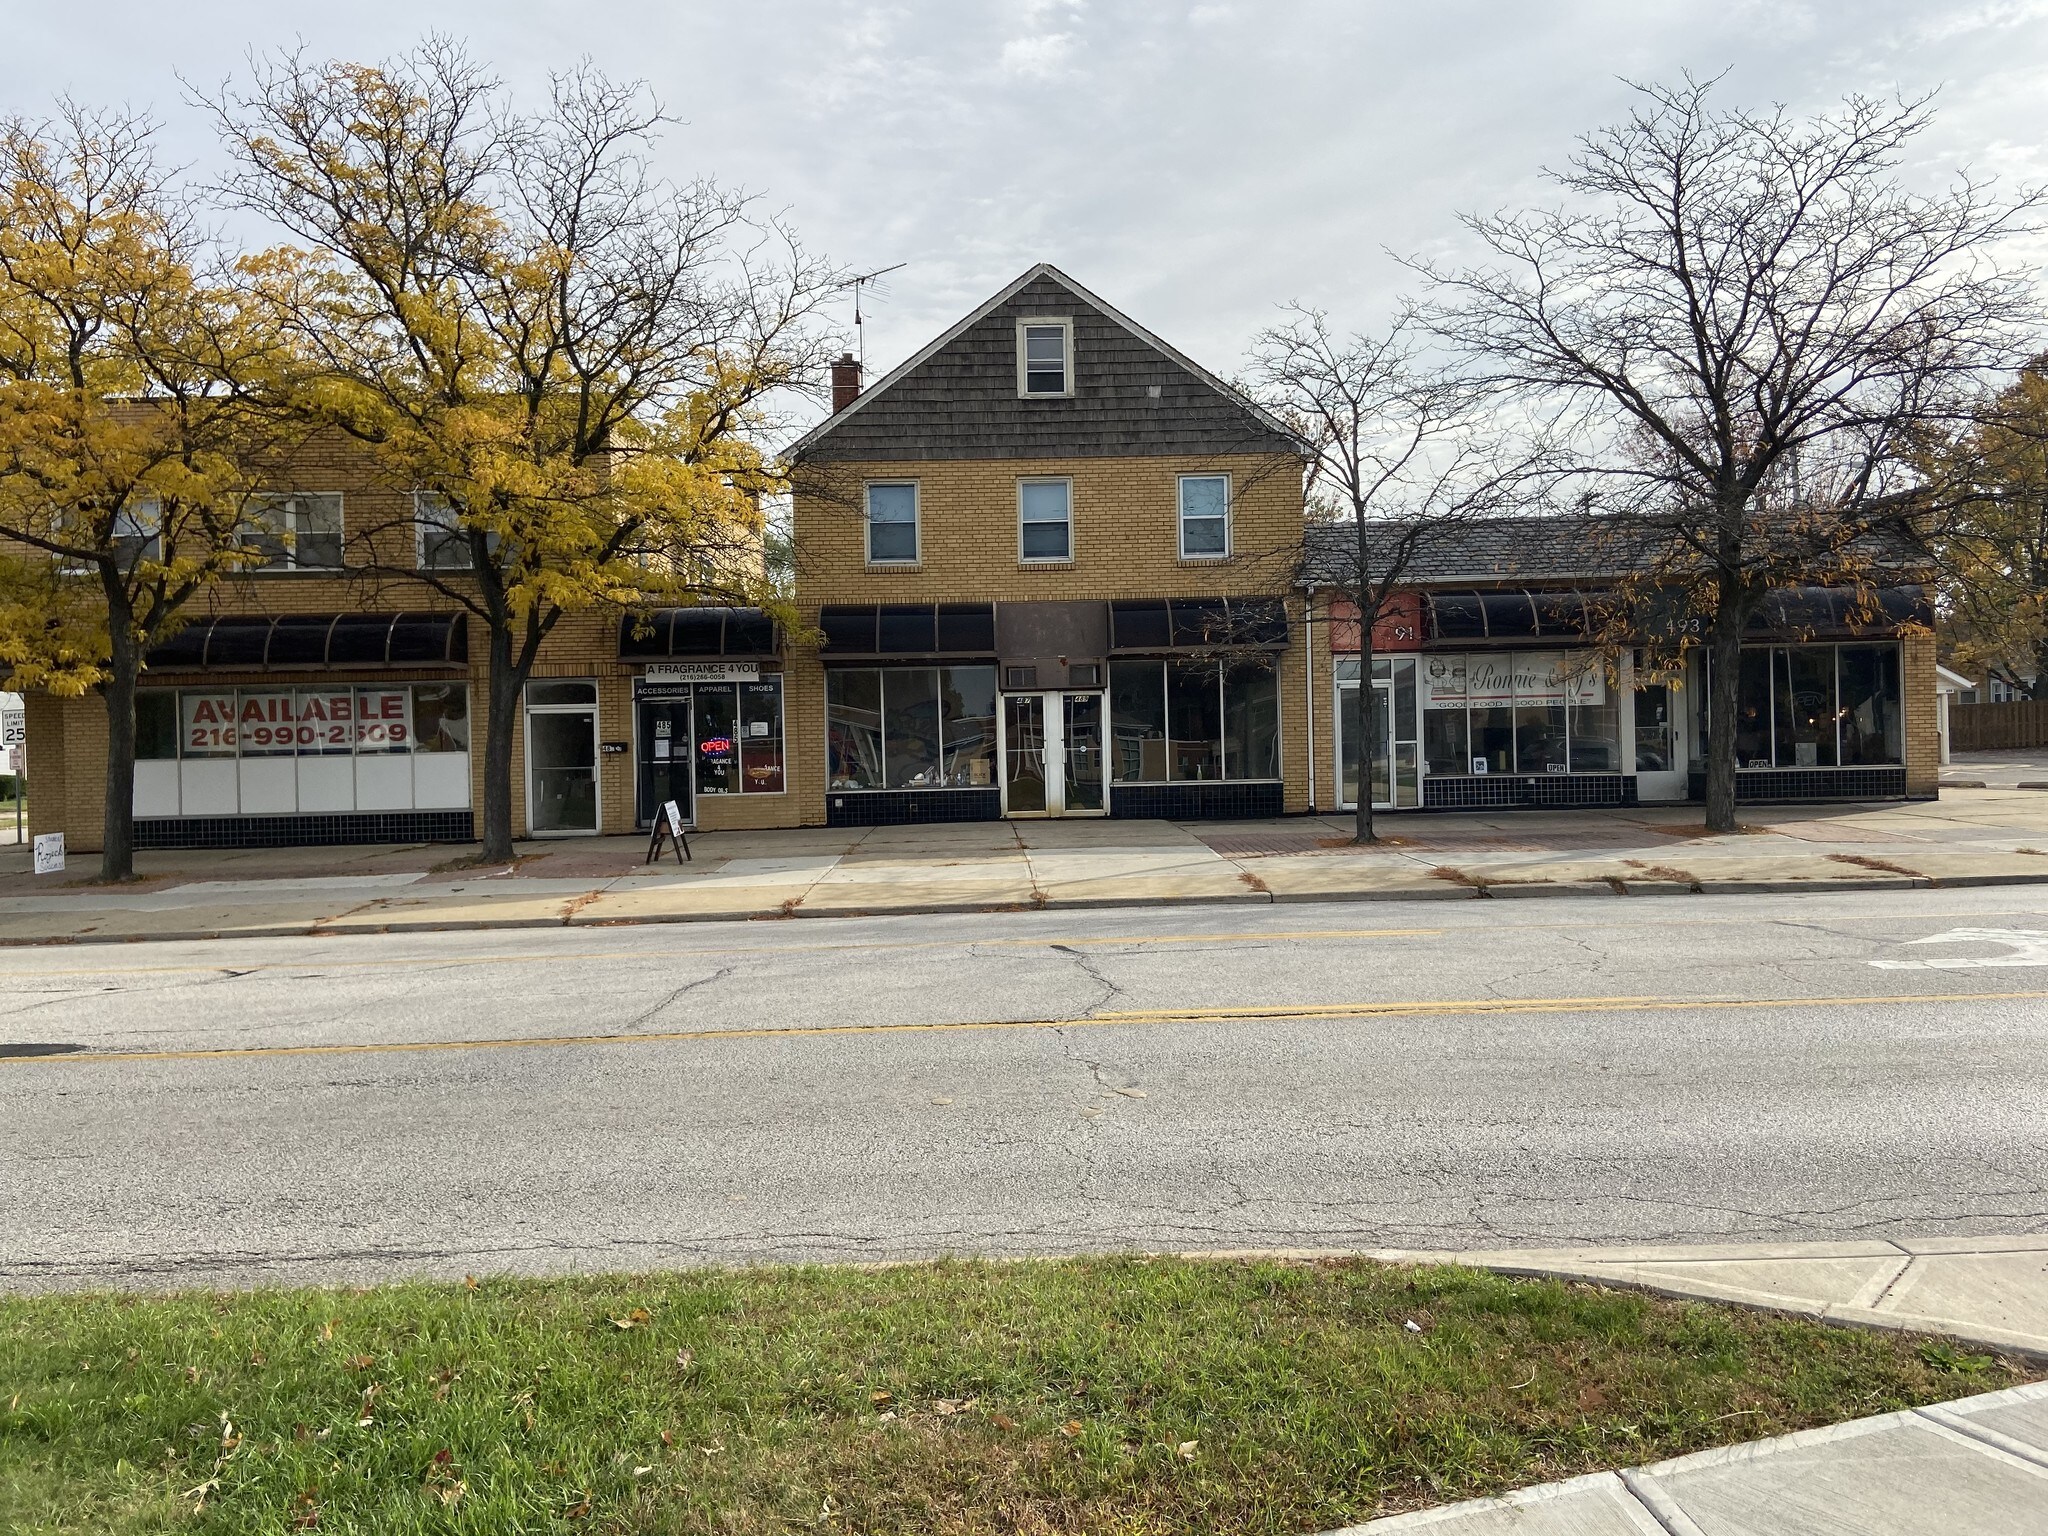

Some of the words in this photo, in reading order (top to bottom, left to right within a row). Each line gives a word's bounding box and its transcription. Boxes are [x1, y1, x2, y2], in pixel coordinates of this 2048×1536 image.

[1386, 626, 1414, 640] 91
[1666, 617, 1700, 636] 493
[647, 665, 655, 674] A
[658, 664, 726, 674] FRAGRANCE
[728, 664, 735, 673] 4
[736, 664, 759, 673] YOU
[1473, 662, 1537, 690] Ronnie
[637, 687, 689, 695] ACCESSORIES
[4, 712, 25, 720] SPEED
[193, 696, 405, 724] AVAILABLE
[656, 721, 671, 730] 485
[6, 728, 26, 742] 25
[191, 723, 408, 747] 216-990-2509
[701, 739, 730, 752] OPEN
[1548, 764, 1565, 772] OPEN
[703, 786, 717, 794] BODY
